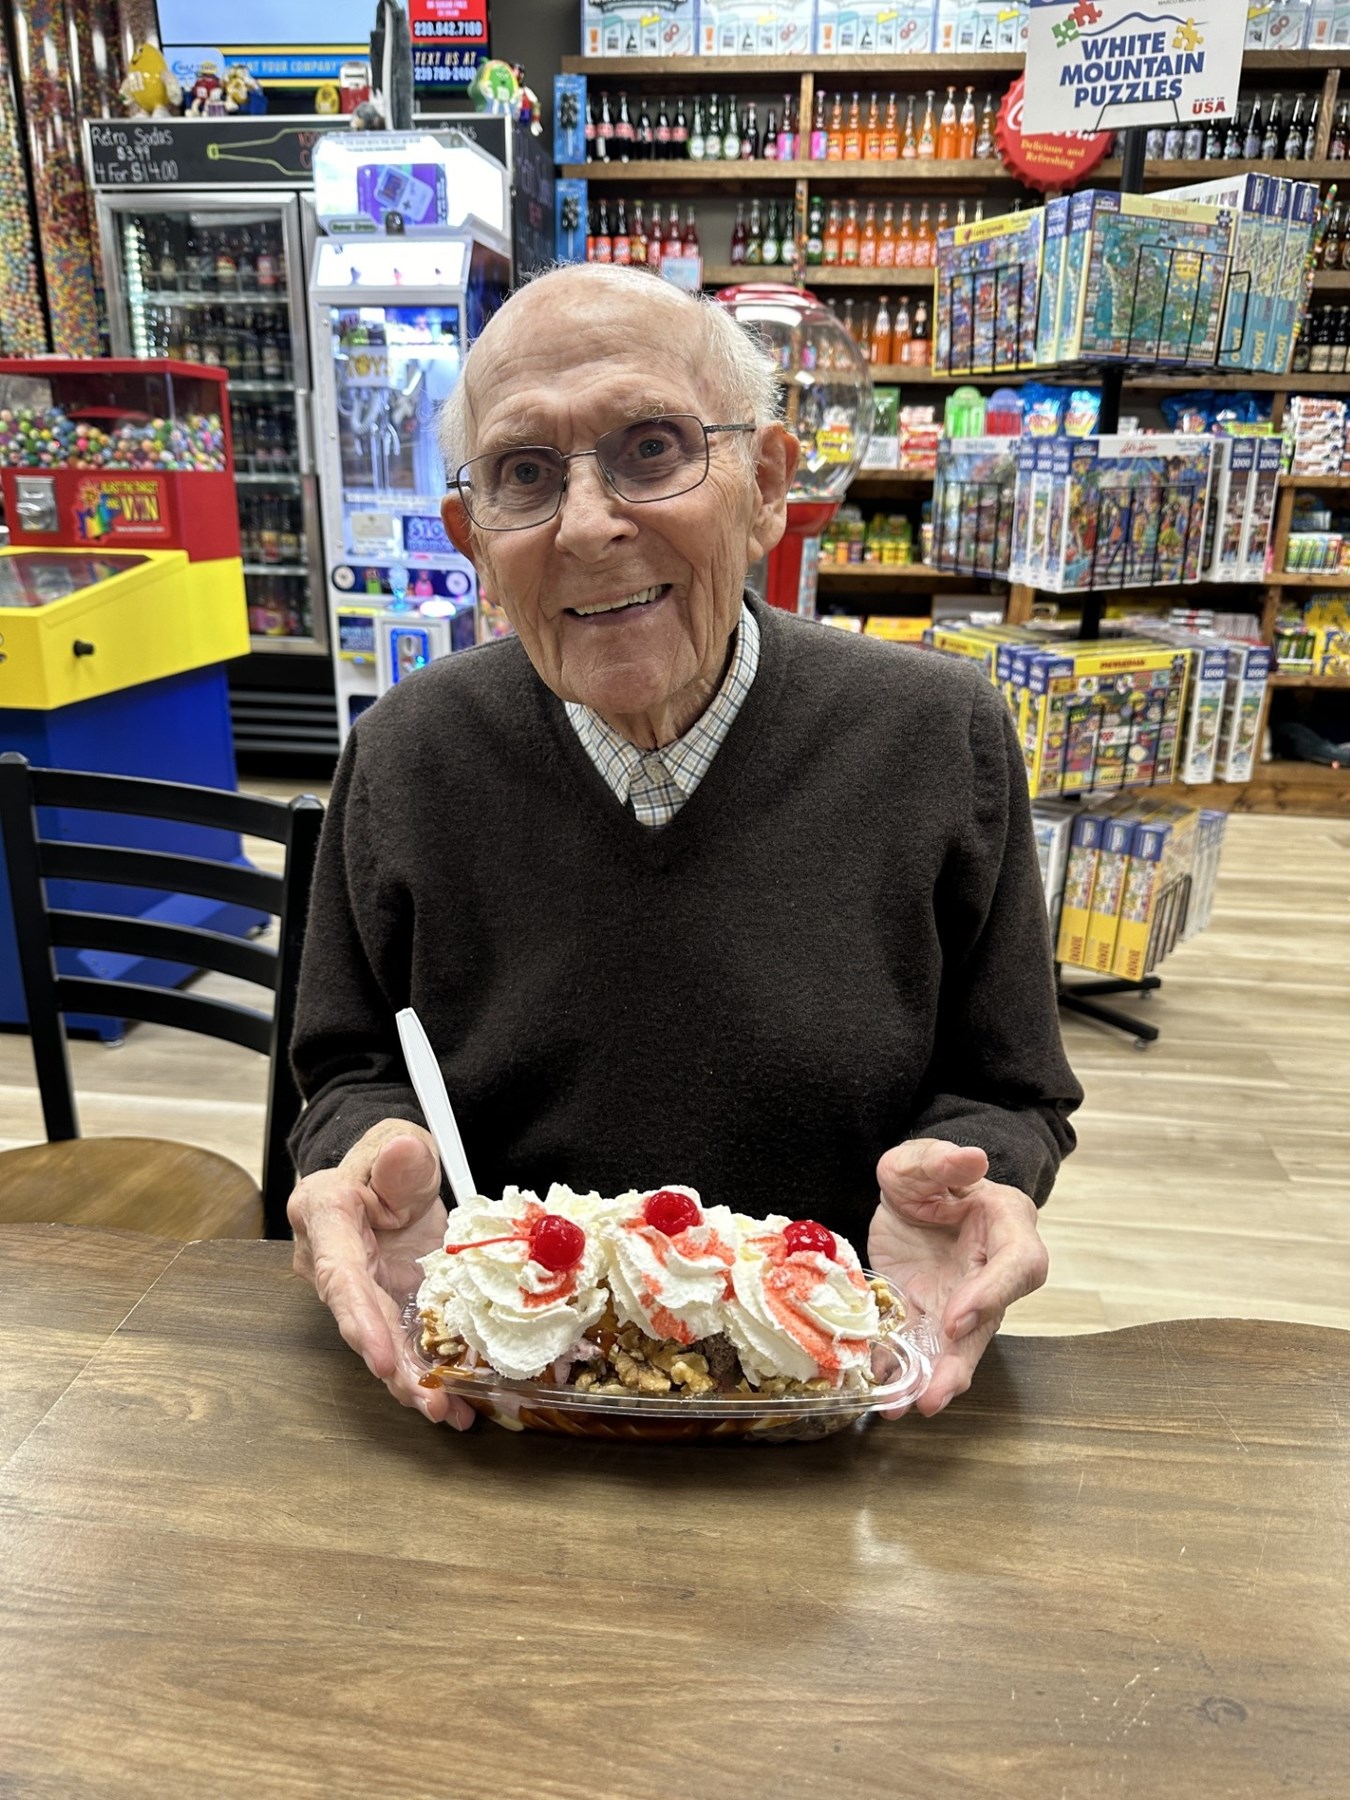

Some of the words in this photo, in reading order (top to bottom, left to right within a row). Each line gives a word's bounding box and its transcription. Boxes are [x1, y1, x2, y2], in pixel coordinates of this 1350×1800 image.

[1081, 31, 1167, 61] WHITE
[415, 51, 442, 66] TEXT
[444, 51, 460, 66] US
[462, 51, 477, 66] AT
[1059, 51, 1205, 87] MOUNTAIN
[1074, 78, 1183, 108] PUZZLES
[1192, 100, 1226, 115] USA
[91, 126, 127, 147] Retro
[134, 126, 174, 146] Sodas
[1021, 138, 1063, 154] Delicious
[1067, 147, 1086, 158] and
[1025, 151, 1075, 170] Refreshing
[94, 162, 106, 183] 4
[1252, 331, 1265, 365] 1000
[1274, 334, 1287, 368] 1000
[1232, 457, 1251, 469] 1000
[1259, 457, 1278, 470] 1000
[120, 495, 160, 522] WIN
[1203, 668, 1224, 679] 1000
[1246, 668, 1266, 679] 1000
